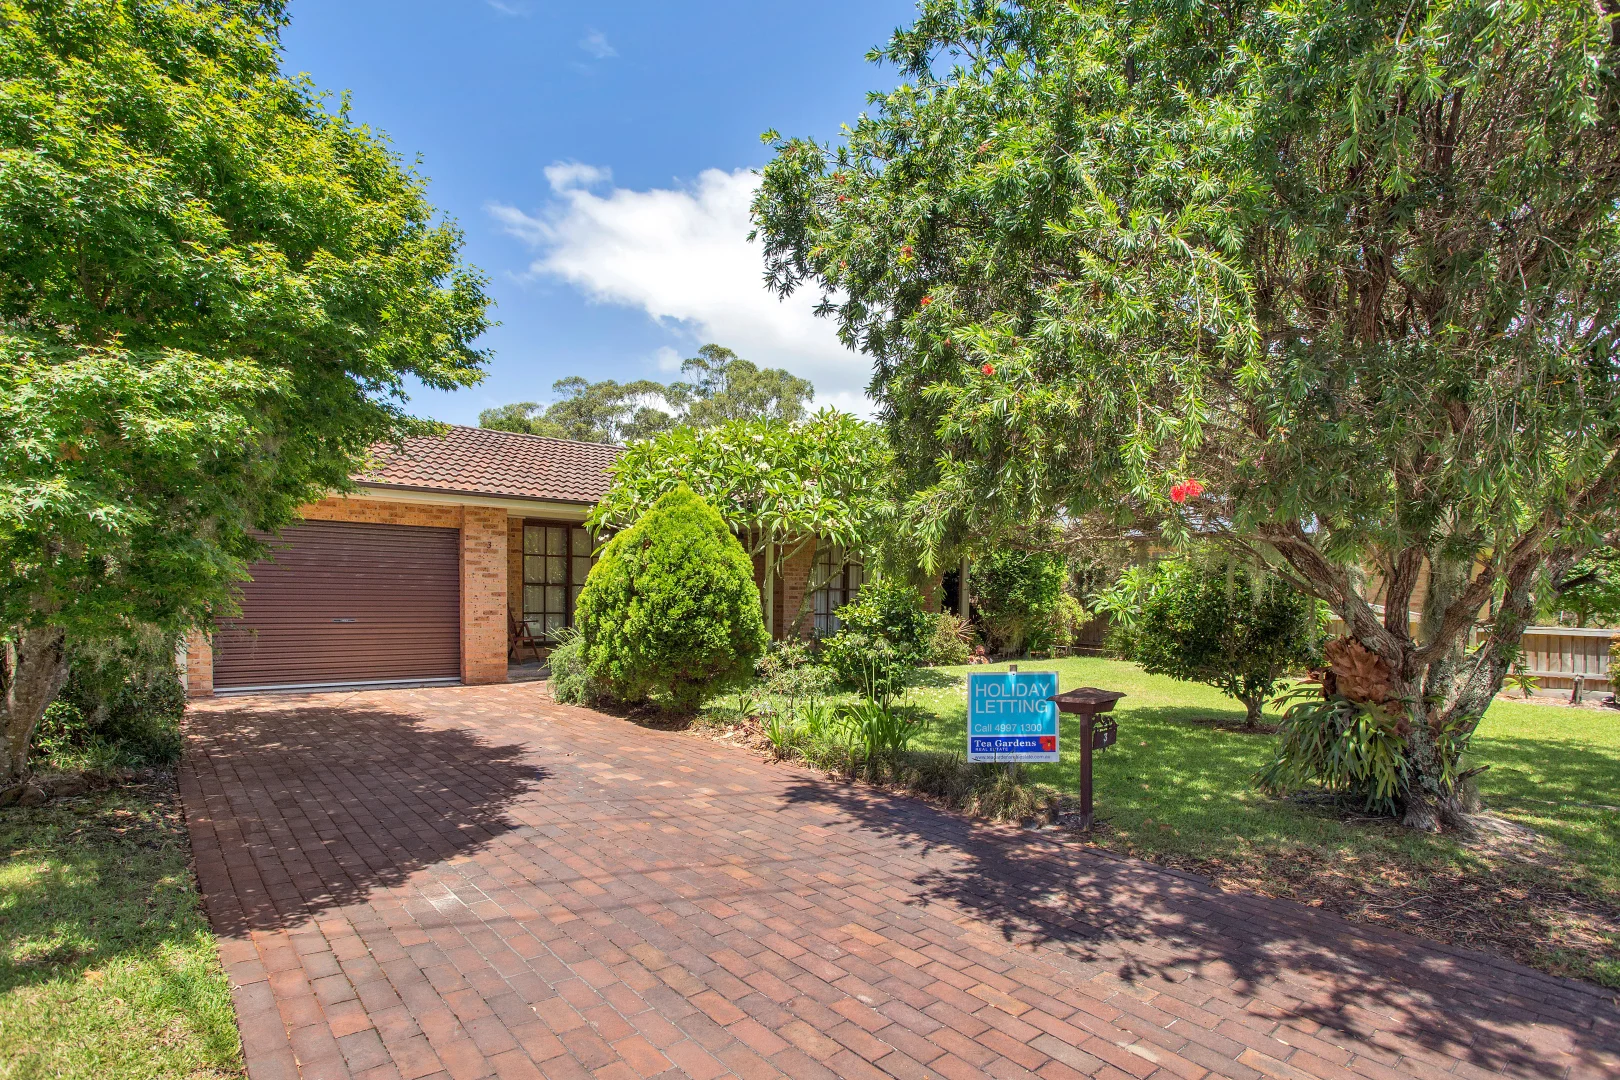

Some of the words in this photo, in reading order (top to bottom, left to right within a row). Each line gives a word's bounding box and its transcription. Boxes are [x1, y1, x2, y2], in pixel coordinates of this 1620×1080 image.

[975, 683, 1050, 697] HOLIDAY
[975, 699, 1048, 714] LETTING
[974, 724, 992, 732] Call
[994, 723, 1017, 732] 4997
[1020, 723, 1042, 732] 1300
[974, 739, 992, 748] Tea
[994, 738, 1037, 747] Gardens
